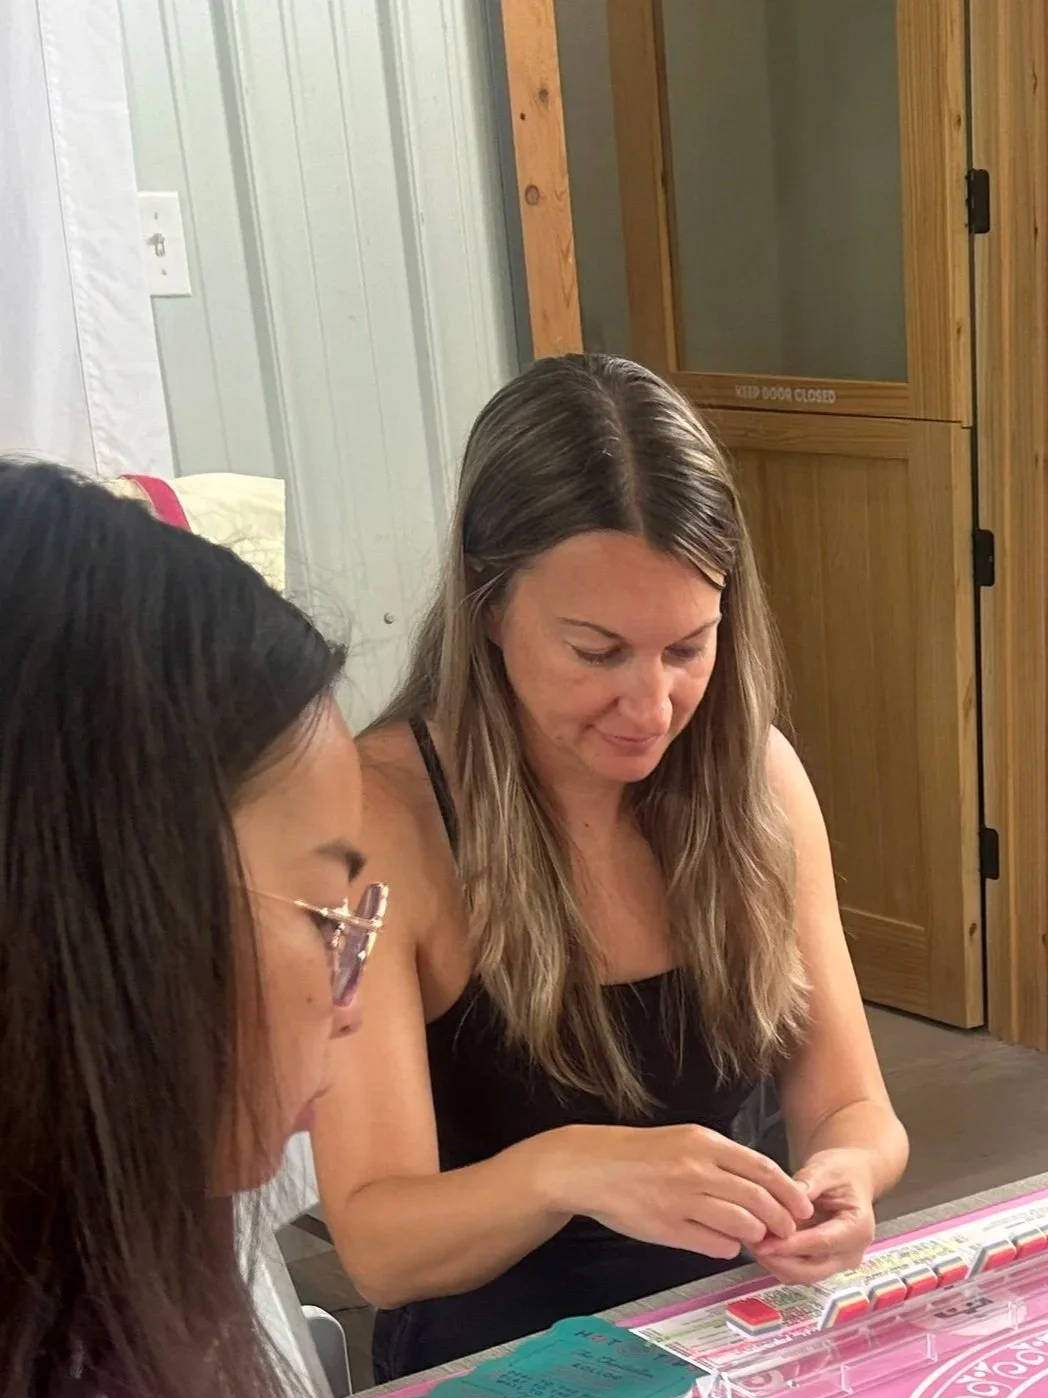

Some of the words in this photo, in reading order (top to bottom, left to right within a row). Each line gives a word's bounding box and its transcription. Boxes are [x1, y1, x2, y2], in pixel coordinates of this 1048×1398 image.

[735, 385, 760, 399] KEEP
[762, 386, 792, 401] DOOR
[794, 388, 836, 403] CLOSED
